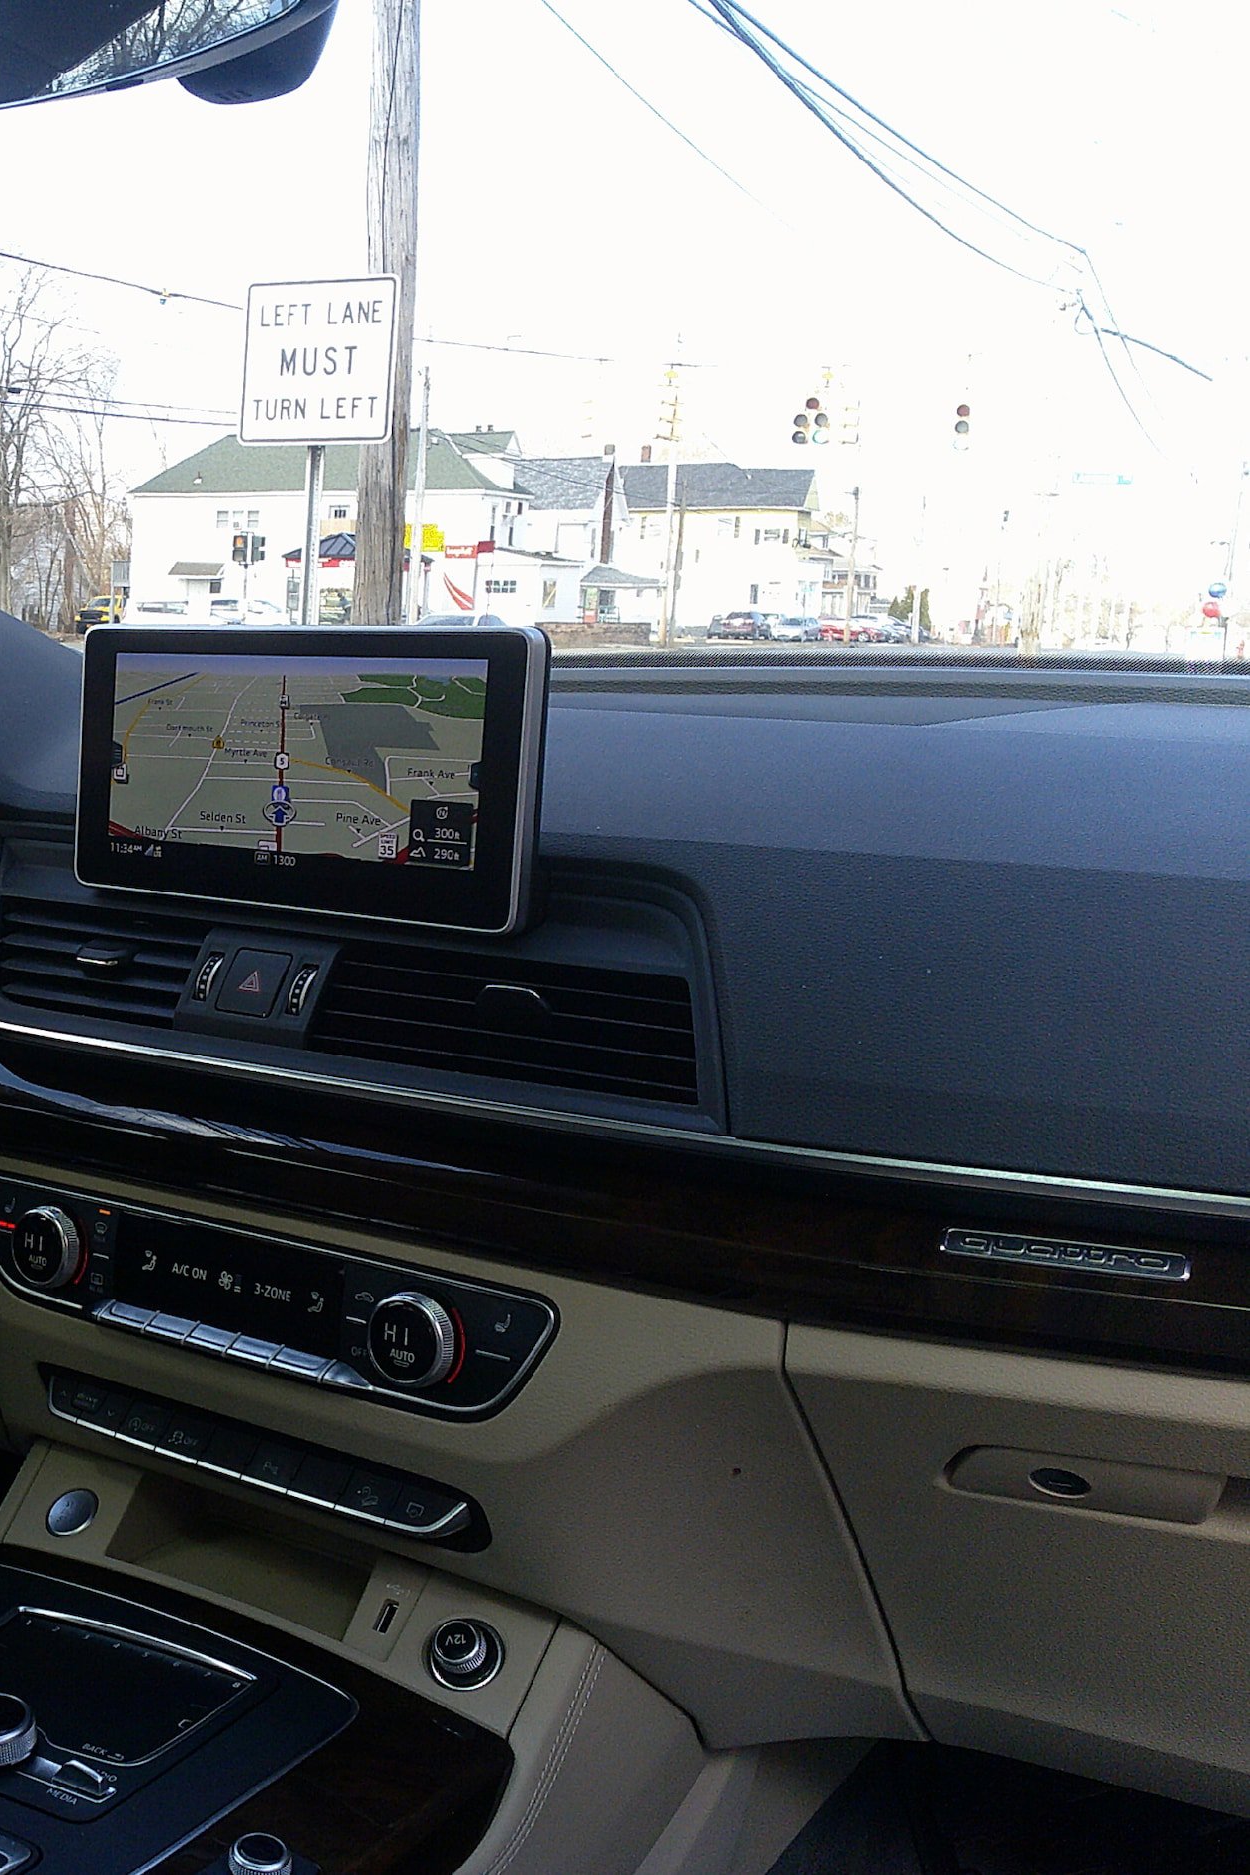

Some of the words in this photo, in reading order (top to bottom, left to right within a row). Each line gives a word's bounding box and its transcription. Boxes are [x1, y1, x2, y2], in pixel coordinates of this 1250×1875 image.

[261, 303, 311, 326] LEFT
[327, 301, 383, 325] LANE
[280, 345, 357, 376] MUST
[252, 398, 307, 421] TURN
[320, 396, 378, 419] LEFT
[224, 747, 250, 758] Myrtle
[252, 749, 268, 758] Ave
[407, 768, 435, 778] Frank
[437, 770, 455, 779] Ave
[200, 811, 233, 823] Selden
[235, 813, 247, 824] St
[336, 813, 359, 824] Pine
[361, 815, 381, 826] Ave
[134, 825, 168, 839] Albany
[170, 829, 183, 840] St
[379, 845, 395, 856] 35
[273, 855, 296, 867] 1300
[24, 1232, 44, 1252] HI
[28, 1254, 48, 1267] AUTO
[171, 1262, 190, 1277] A/C
[191, 1267, 208, 1281] ON
[254, 1282, 292, 1302] 3-ZONE
[384, 1322, 409, 1347] HI
[390, 1348, 416, 1363] AUTO
[445, 1633, 467, 1646] 12V
[82, 1742, 108, 1756] BACK
[46, 1787, 78, 1805] MEDIA
